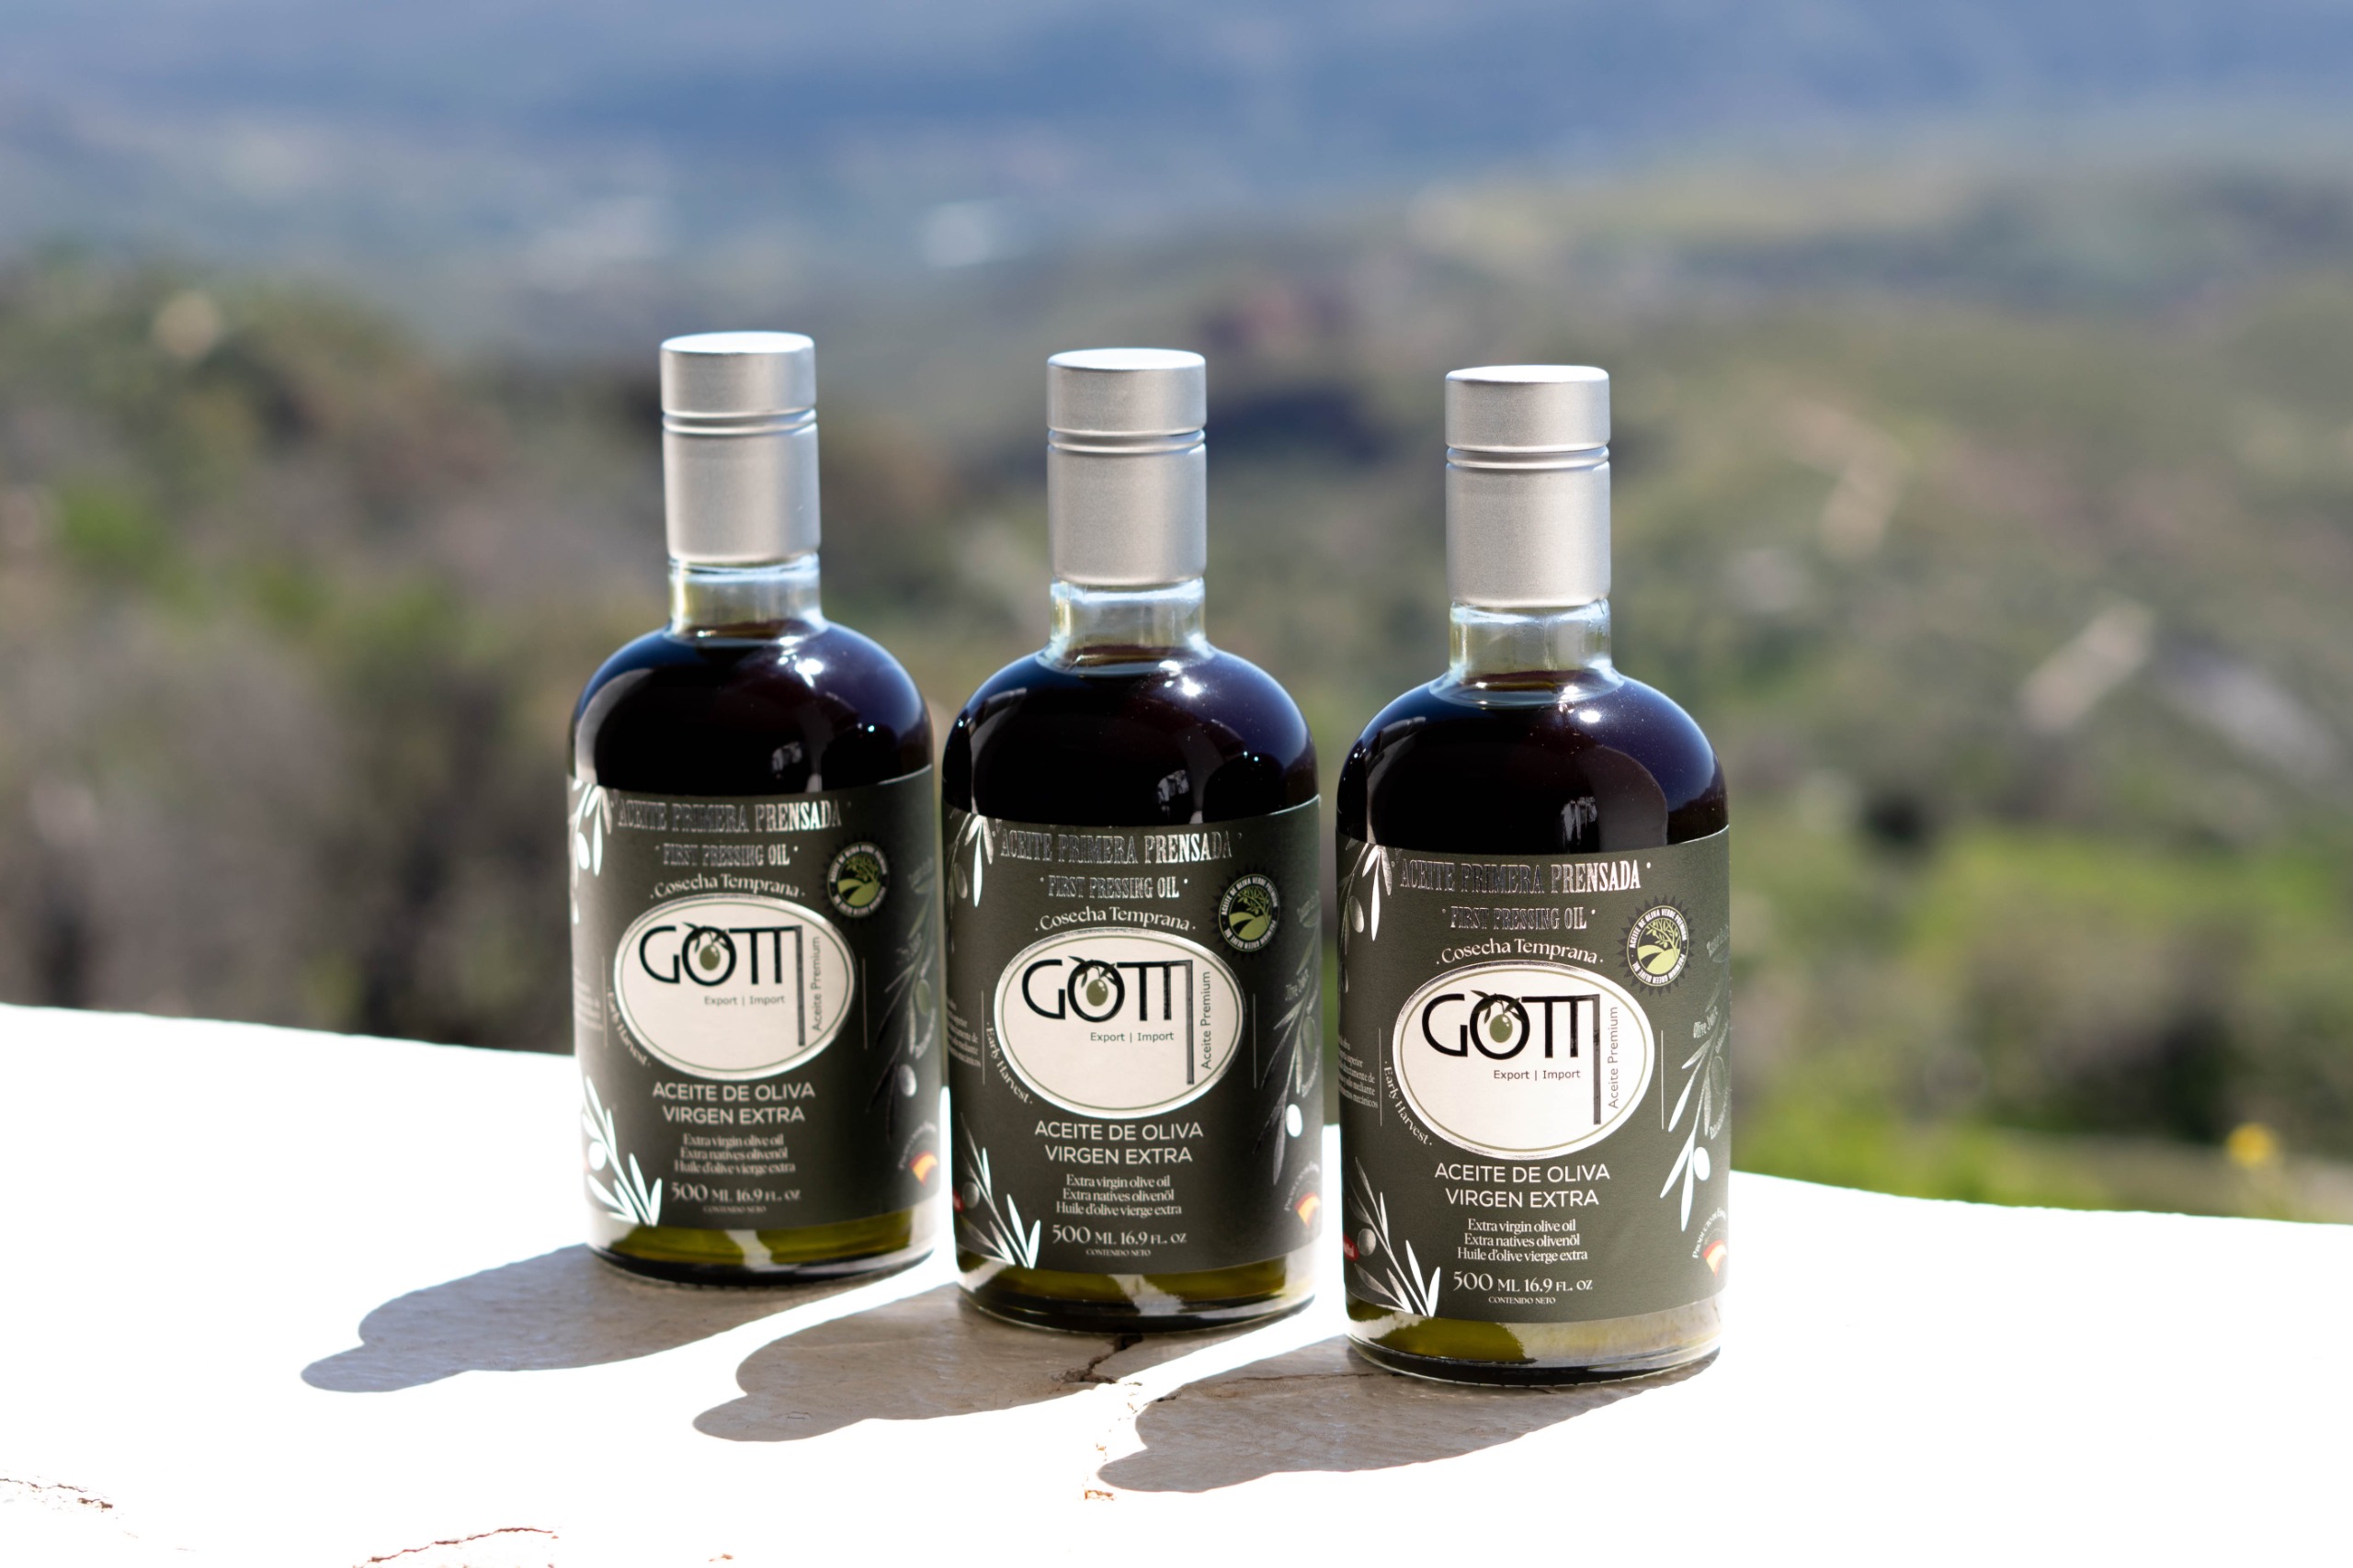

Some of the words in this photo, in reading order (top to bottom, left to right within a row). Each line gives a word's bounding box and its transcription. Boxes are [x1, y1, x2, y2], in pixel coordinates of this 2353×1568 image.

[755, 800, 842, 833] PRENSADA
[663, 842, 699, 866] FIRST
[768, 844, 790, 866] OIL
[1000, 829, 1052, 861] ACEITE
[1058, 834, 1139, 865] PRIMERA
[1144, 831, 1233, 864] PRENSADA
[654, 873, 718, 898] Cosecha
[722, 873, 800, 898] Temprana
[1048, 874, 1086, 898] FIRST
[1089, 876, 1153, 899] PRESSING
[1157, 876, 1179, 899] OIL
[1400, 858, 1455, 892] ACEITE
[1461, 863, 1545, 894] PRIMERA
[1551, 859, 1642, 893] PRENSADA
[1040, 905, 1107, 931] Cosecha
[1109, 906, 1189, 931] Temprana
[1450, 905, 1489, 929] FIRST
[1493, 907, 1559, 930] PRESSING
[1564, 906, 1587, 929] OIL
[1629, 926, 1642, 949] ACEITE
[1644, 909, 1660, 922] OLIVA
[1662, 908, 1676, 919] VERDE
[1441, 937, 1511, 963] Cosecha
[1514, 938, 1597, 964] Temprana
[811, 936, 821, 991] Premium
[704, 995, 738, 1006] Export
[749, 995, 786, 1006] Import
[1200, 971, 1211, 1027] Premium
[812, 994, 823, 1031] Aceite
[1090, 1032, 1125, 1043] Export
[1138, 1032, 1175, 1042] Import
[1608, 1006, 1619, 1063] Premium
[1201, 1030, 1211, 1070] Aceite
[996, 1060, 1029, 1103] Harvest
[1494, 1070, 1529, 1081] Export
[1542, 1069, 1581, 1080] Import
[653, 1082, 718, 1101] ACEITE
[723, 1085, 750, 1102] DE
[755, 1082, 815, 1101] OLIVA
[1608, 1067, 1619, 1108] Aceite
[663, 1105, 733, 1124] VIRGEN
[739, 1106, 805, 1124] EXTRA
[1384, 1066, 1399, 1099] Early
[1395, 1100, 1428, 1144] Harvest
[1034, 1120, 1103, 1140] ACEITE
[1108, 1124, 1136, 1141] DE
[1142, 1121, 1204, 1141] OLIVA
[1044, 1144, 1119, 1165] VIRGEN
[1126, 1147, 1193, 1165] EXTRA
[1066, 1174, 1095, 1187] Extra
[1097, 1176, 1128, 1190] virgin
[1129, 1176, 1154, 1187] olive
[1156, 1175, 1170, 1187] oil
[1434, 1163, 1506, 1183] ACEITE
[1512, 1166, 1541, 1183] DE
[1547, 1164, 1610, 1183] OLIVA
[672, 1181, 709, 1202] 500
[1063, 1187, 1091, 1200] Extra
[1093, 1189, 1131, 1201] natives
[1445, 1188, 1522, 1208] VIRGEN
[1529, 1189, 1599, 1208] EXTRA
[1056, 1201, 1085, 1214] Huile
[1120, 1205, 1154, 1218] vierge
[1154, 1204, 1182, 1215] extra
[1052, 1224, 1091, 1244] 500
[1095, 1232, 1117, 1245] ML
[1120, 1231, 1148, 1245] 16.9
[1468, 1218, 1498, 1232] Extra
[1499, 1221, 1532, 1234] virgin
[1534, 1220, 1560, 1233] olive
[1562, 1219, 1576, 1232] oil
[1464, 1233, 1495, 1246] Extra
[1495, 1234, 1534, 1247] natives
[1536, 1233, 1580, 1247] olivenöl
[1457, 1247, 1487, 1261] Huile
[1524, 1251, 1559, 1264] vierge
[1560, 1249, 1587, 1261] extra
[1453, 1270, 1494, 1290] 500
[1497, 1278, 1520, 1292] ML
[1524, 1278, 1552, 1293] 16.9
[1556, 1281, 1573, 1292] FL.
[1576, 1279, 1593, 1290] OZ
[1488, 1296, 1534, 1304] CONTENIDO
